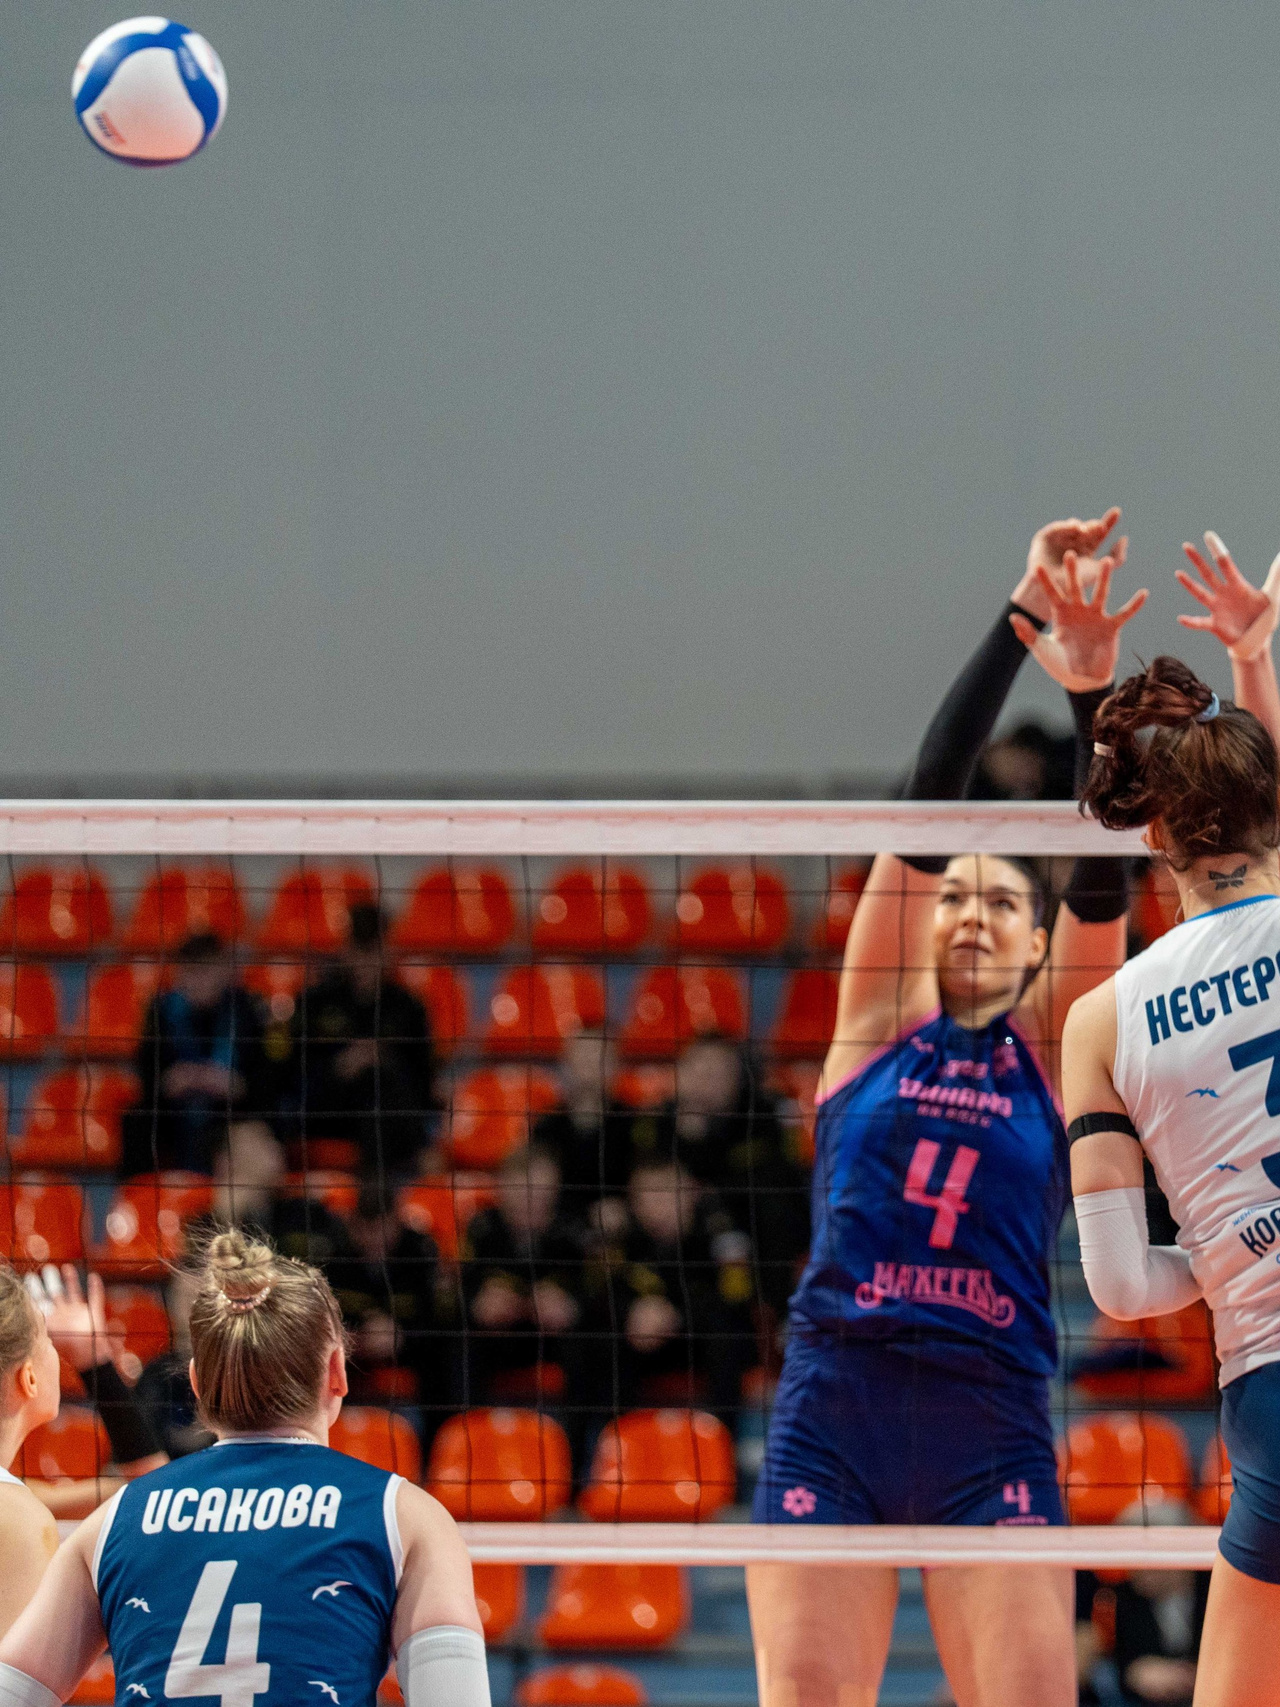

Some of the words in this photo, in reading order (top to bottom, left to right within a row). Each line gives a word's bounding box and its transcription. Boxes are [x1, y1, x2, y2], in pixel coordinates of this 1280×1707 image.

[903, 1137, 981, 1250] 4
[142, 1484, 342, 1535] ИСАКОВА
[1003, 1480, 1032, 1514] 4
[164, 1560, 270, 1707] 4
